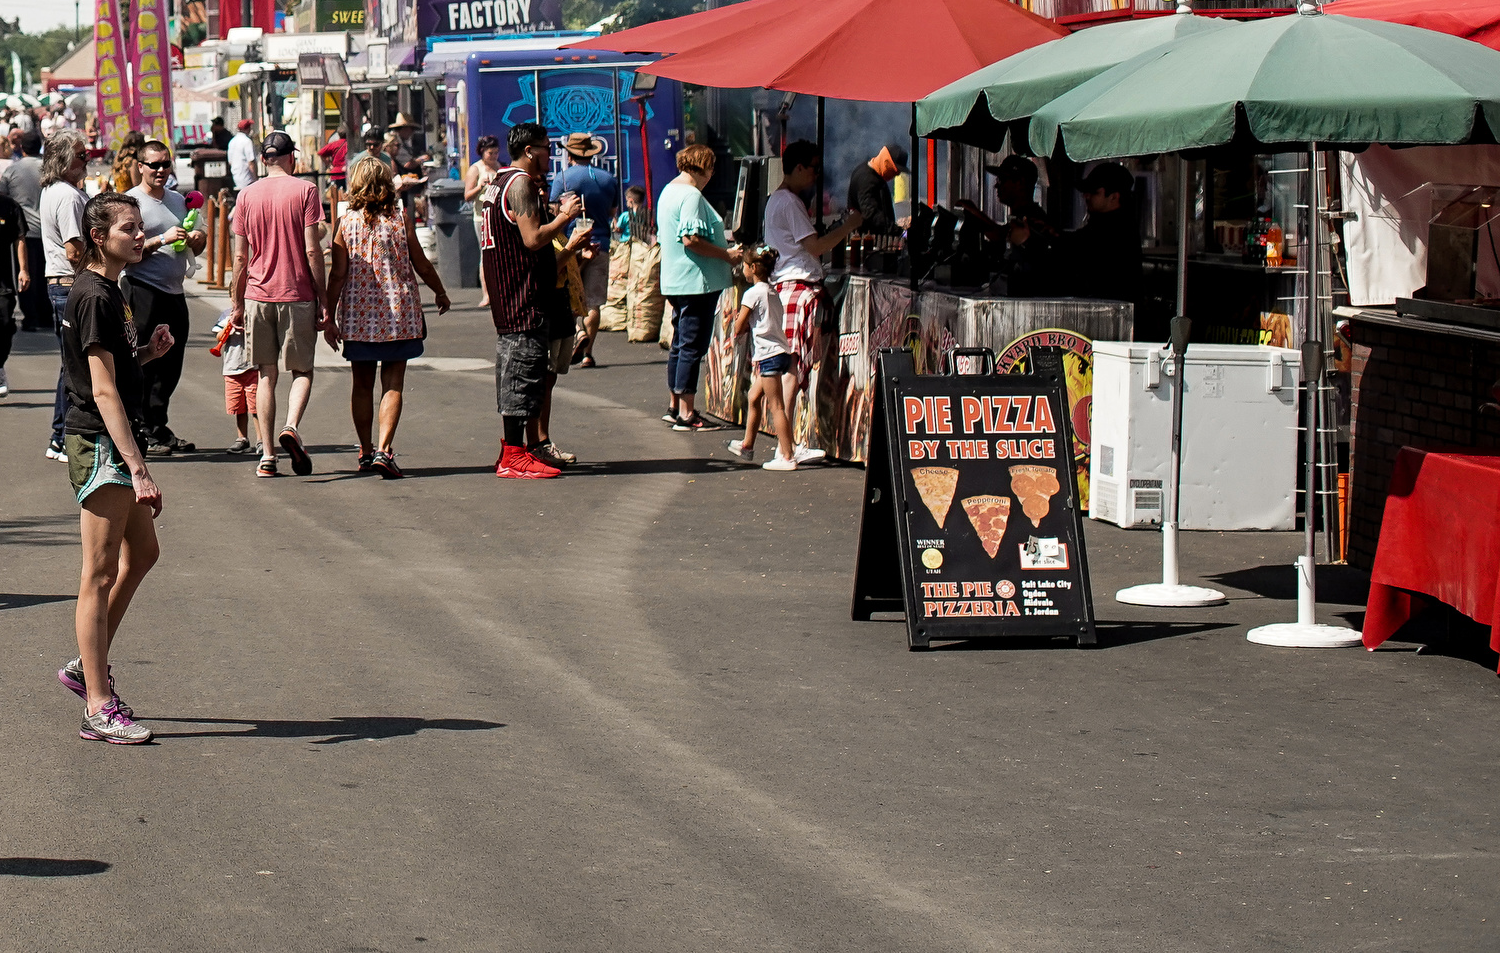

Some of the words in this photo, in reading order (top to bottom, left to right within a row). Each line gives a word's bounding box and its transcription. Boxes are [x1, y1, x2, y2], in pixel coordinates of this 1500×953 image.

[1050, 333, 1077, 349] BBQ
[903, 396, 953, 434] PIE
[961, 396, 1056, 434] PIZZA
[909, 440, 940, 459] BY
[946, 440, 989, 459] THE
[996, 439, 1056, 459] SLICE
[967, 497, 1007, 505] Pepperoni
[920, 582, 959, 598] THE
[961, 581, 994, 597] PIE
[1057, 580, 1072, 590] City
[1023, 590, 1046, 598] Ogden
[1024, 598, 1054, 606] Midvale
[923, 601, 1021, 617] PIZZERIA
[1033, 608, 1059, 616] Jordan
